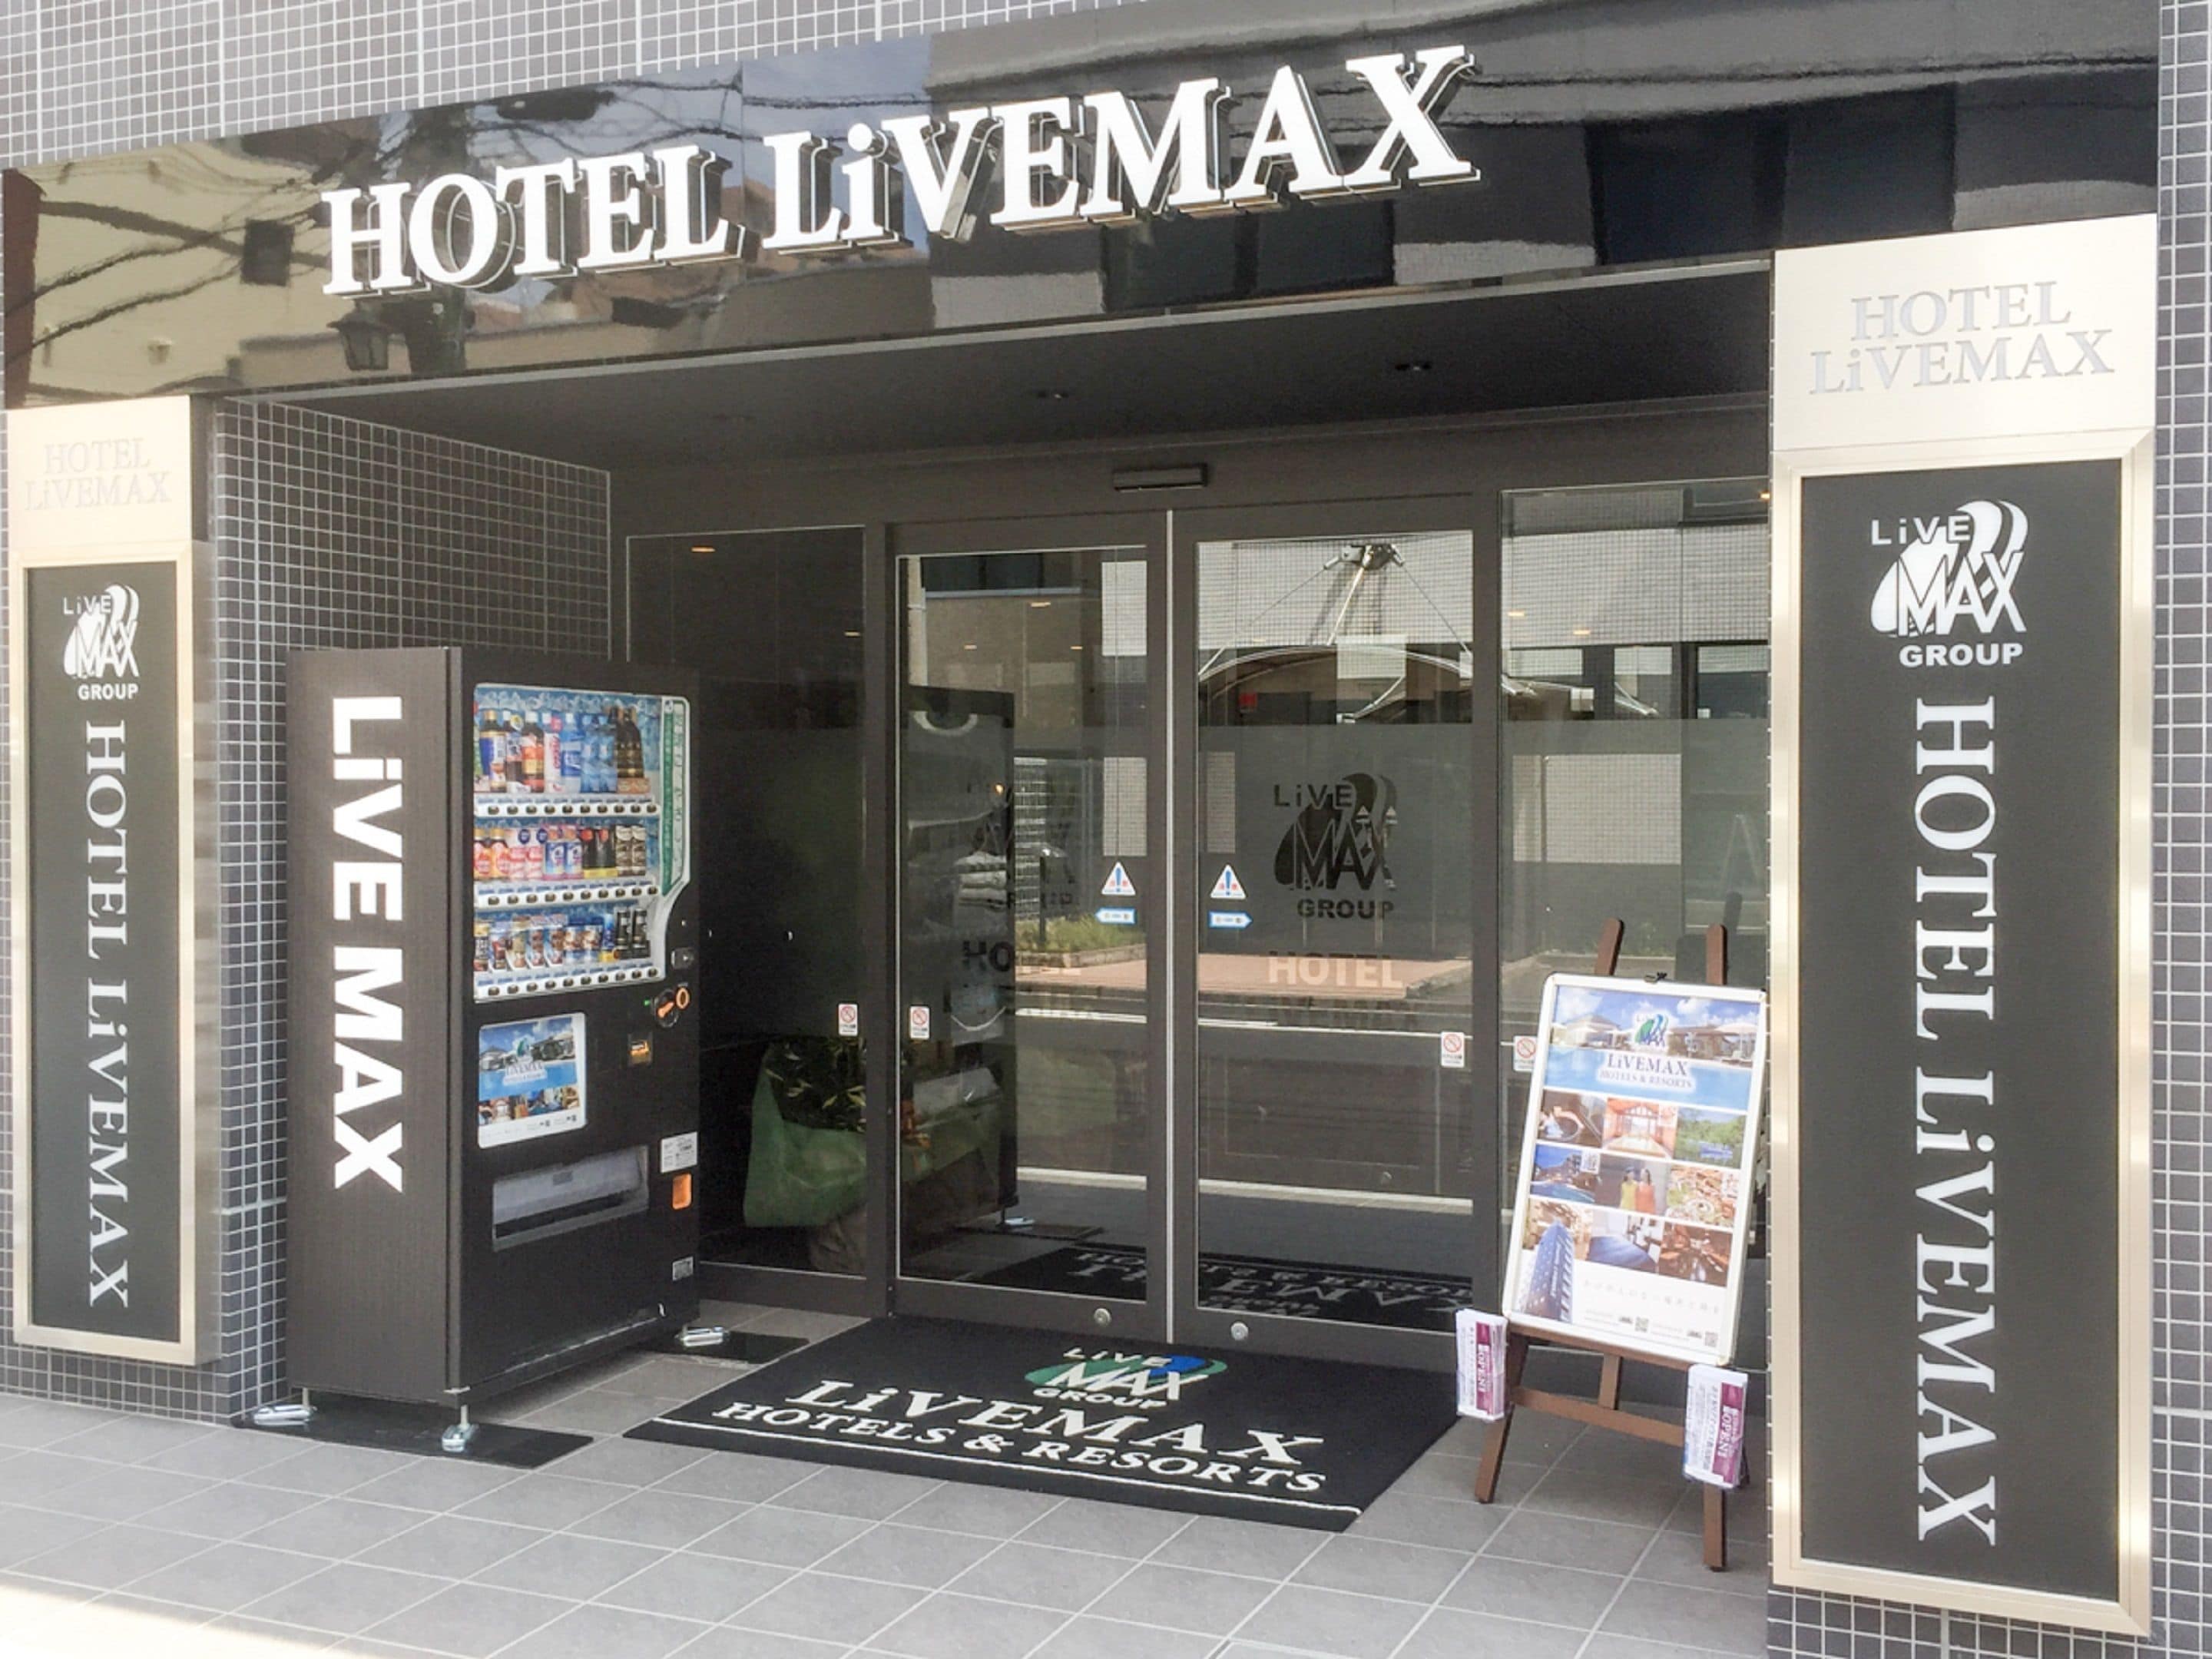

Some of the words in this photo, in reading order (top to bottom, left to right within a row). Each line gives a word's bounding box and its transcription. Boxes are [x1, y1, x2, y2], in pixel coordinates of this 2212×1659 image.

[320, 144, 736, 298] HOTEL
[762, 45, 1476, 250] LiVEMAX
[1850, 280, 2071, 342] HOTEL
[1809, 329, 2115, 395] LiVEMAX
[43, 436, 152, 474] HOTEL
[25, 469, 172, 511] LiVEMAX
[1870, 514, 1972, 546] LiVE
[62, 594, 113, 614] LiVE
[1898, 551, 2028, 637] MAX
[78, 618, 140, 678] MAX
[1899, 643, 2024, 667] GROUP
[78, 683, 139, 700] GROUP
[333, 697, 403, 922] LiVE
[1273, 783, 1353, 808] LiVE
[86, 720, 128, 960] HOTEL
[1294, 817, 1396, 891] MAX
[1915, 696, 1997, 1041] HOTEL
[1296, 898, 1395, 919] GROUP
[1268, 950, 1404, 988] HOTEL
[335, 946, 403, 1194] MAX
[88, 979, 129, 1307] LiVEMAX
[1916, 1066, 1997, 1546] LiVEMAX
[1033, 1387, 1167, 1409] GROUP
[1045, 1362, 1209, 1400] MAX
[711, 1402, 956, 1444] HOTELS
[962, 1433, 1015, 1453] &
[1022, 1440, 1327, 1492] RESORTS
[784, 1379, 1325, 1465] LiVEMAX
